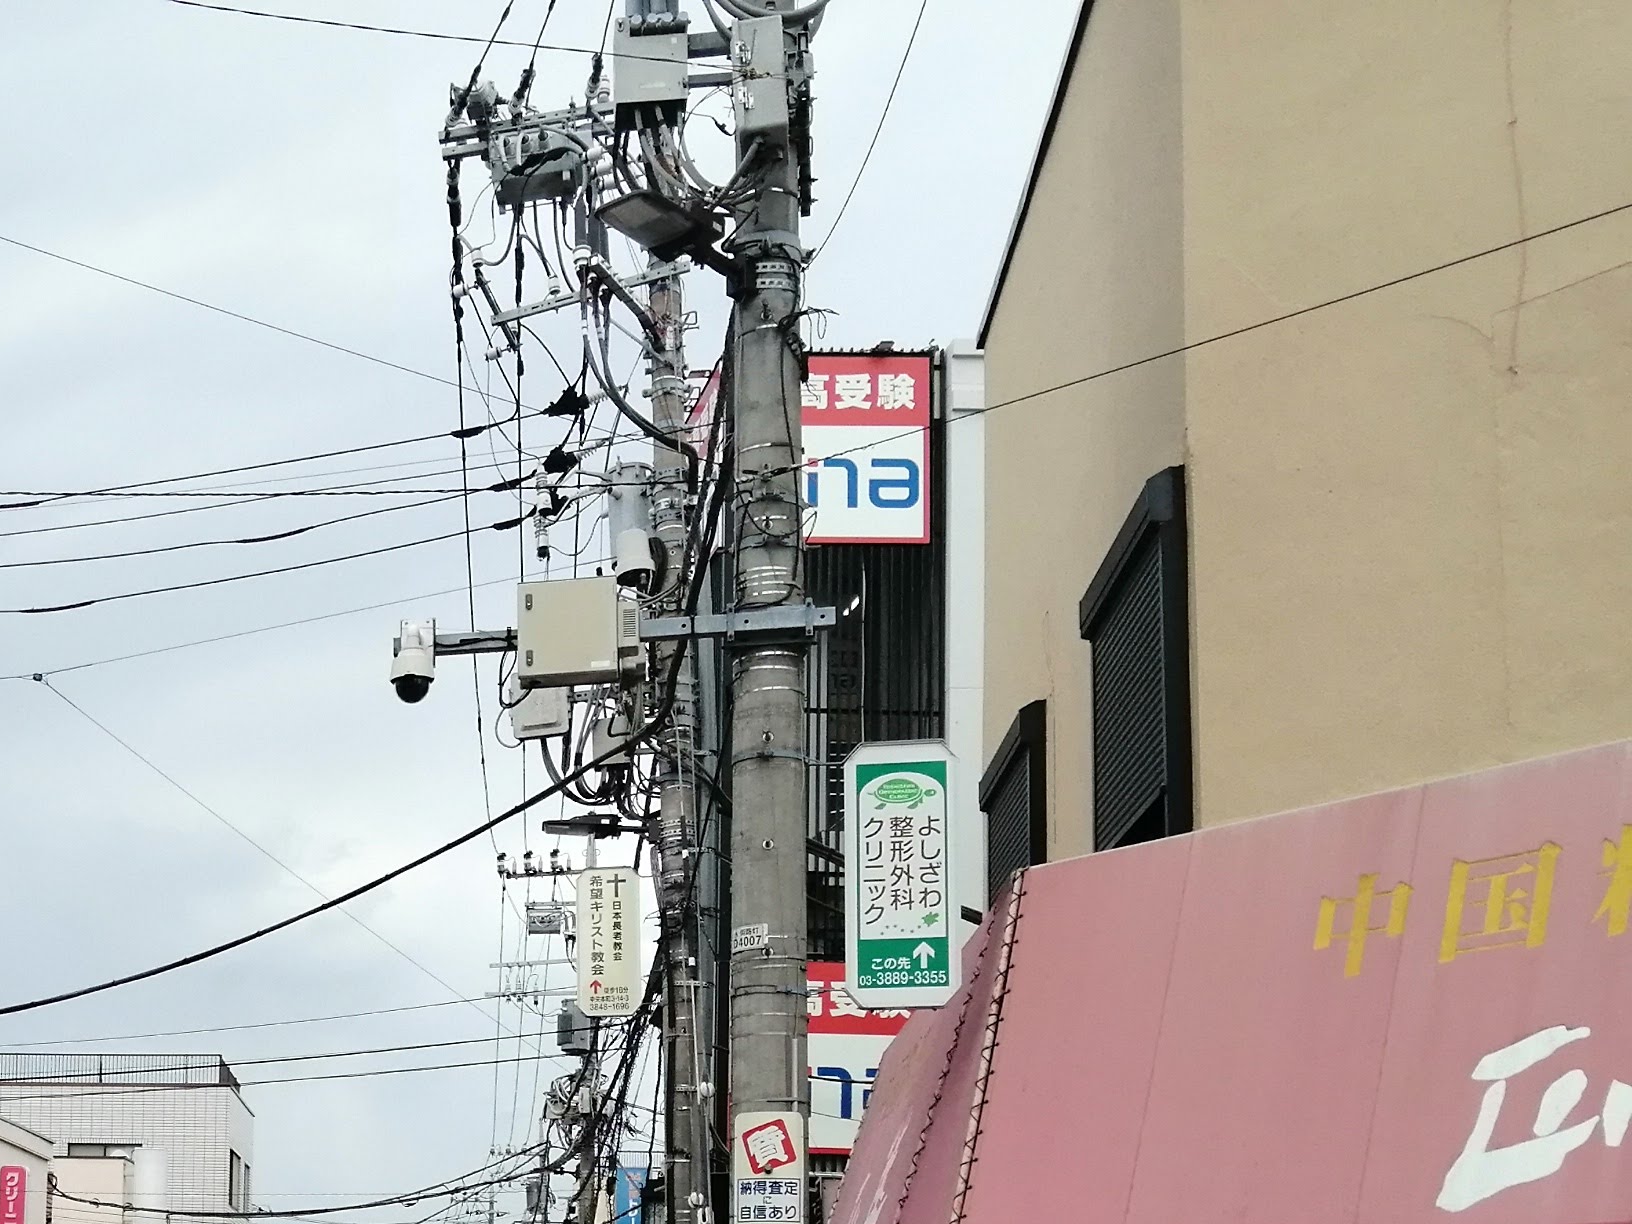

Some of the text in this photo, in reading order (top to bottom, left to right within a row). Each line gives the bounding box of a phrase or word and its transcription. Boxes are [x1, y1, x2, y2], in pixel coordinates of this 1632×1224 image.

[863, 816, 887, 926] クリニック
[889, 815, 915, 912] 整形外科
[917, 815, 943, 909] よしざわ
[589, 875, 605, 976] 希望キリスト教会
[859, 970, 947, 986] 03-3889-3355
[871, 956, 911, 970] この先
[739, 1180, 799, 1196] 納得査定
[739, 1204, 798, 1220] 自信あり
